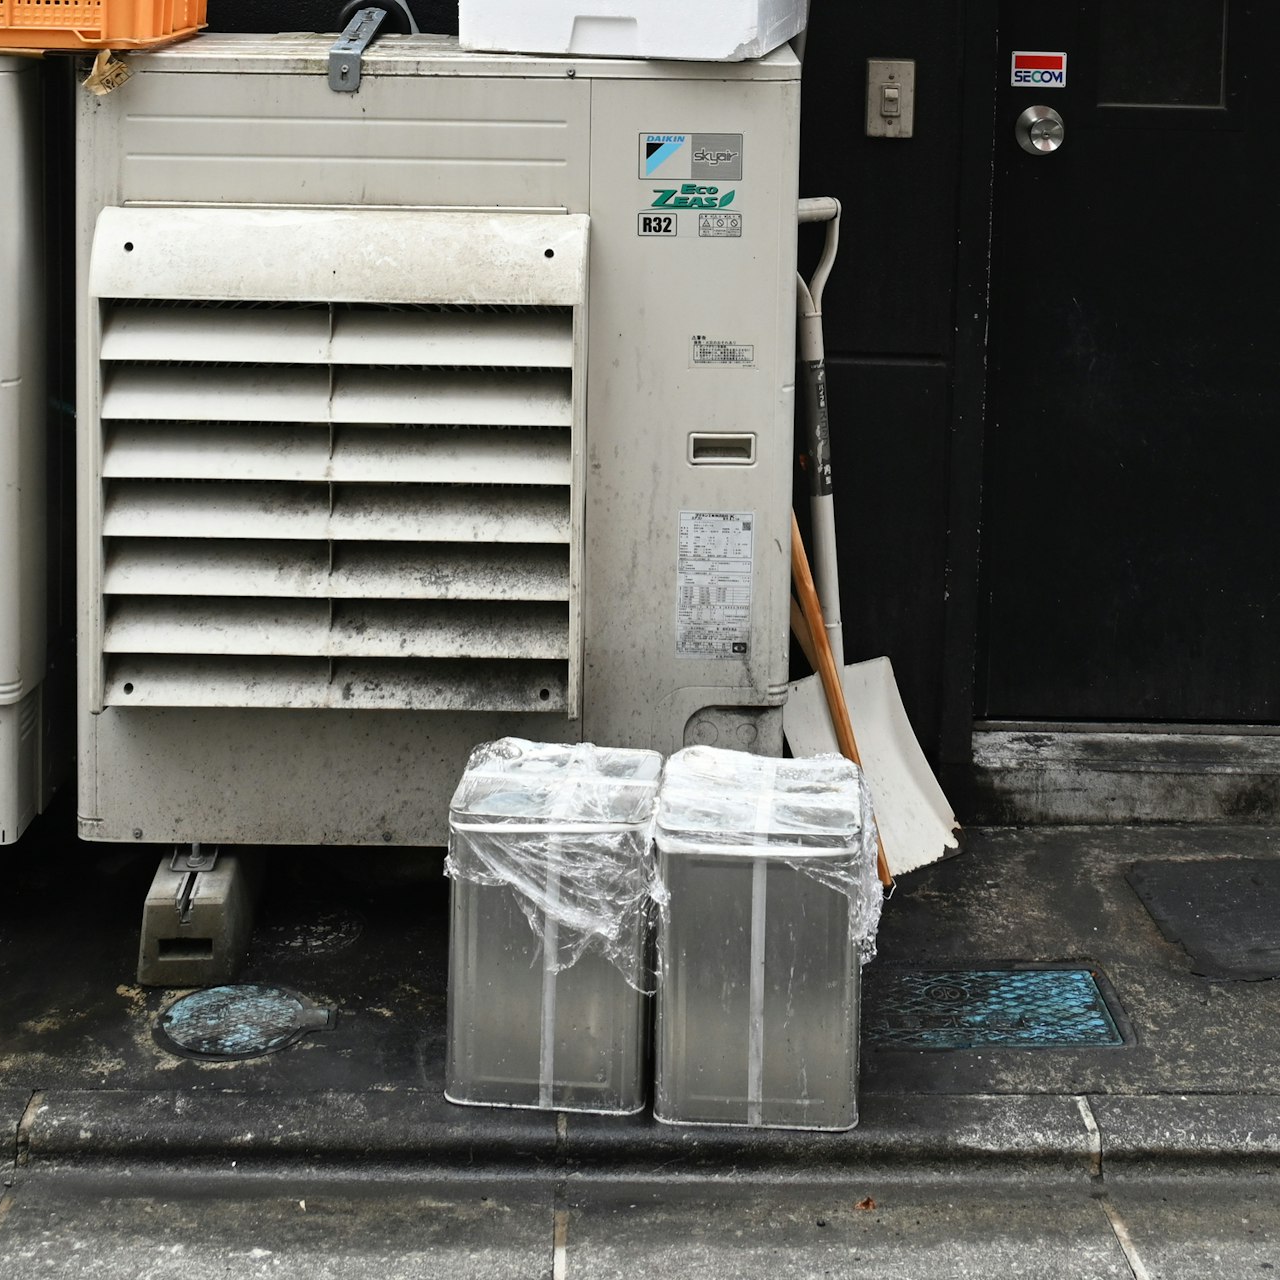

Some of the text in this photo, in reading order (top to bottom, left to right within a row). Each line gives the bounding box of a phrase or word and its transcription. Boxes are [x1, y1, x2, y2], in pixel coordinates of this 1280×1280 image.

[1014, 70, 1063, 84] SECOM
[646, 135, 686, 143] DAIKIN
[693, 147, 739, 166] skyair
[642, 216, 672, 233] R32
